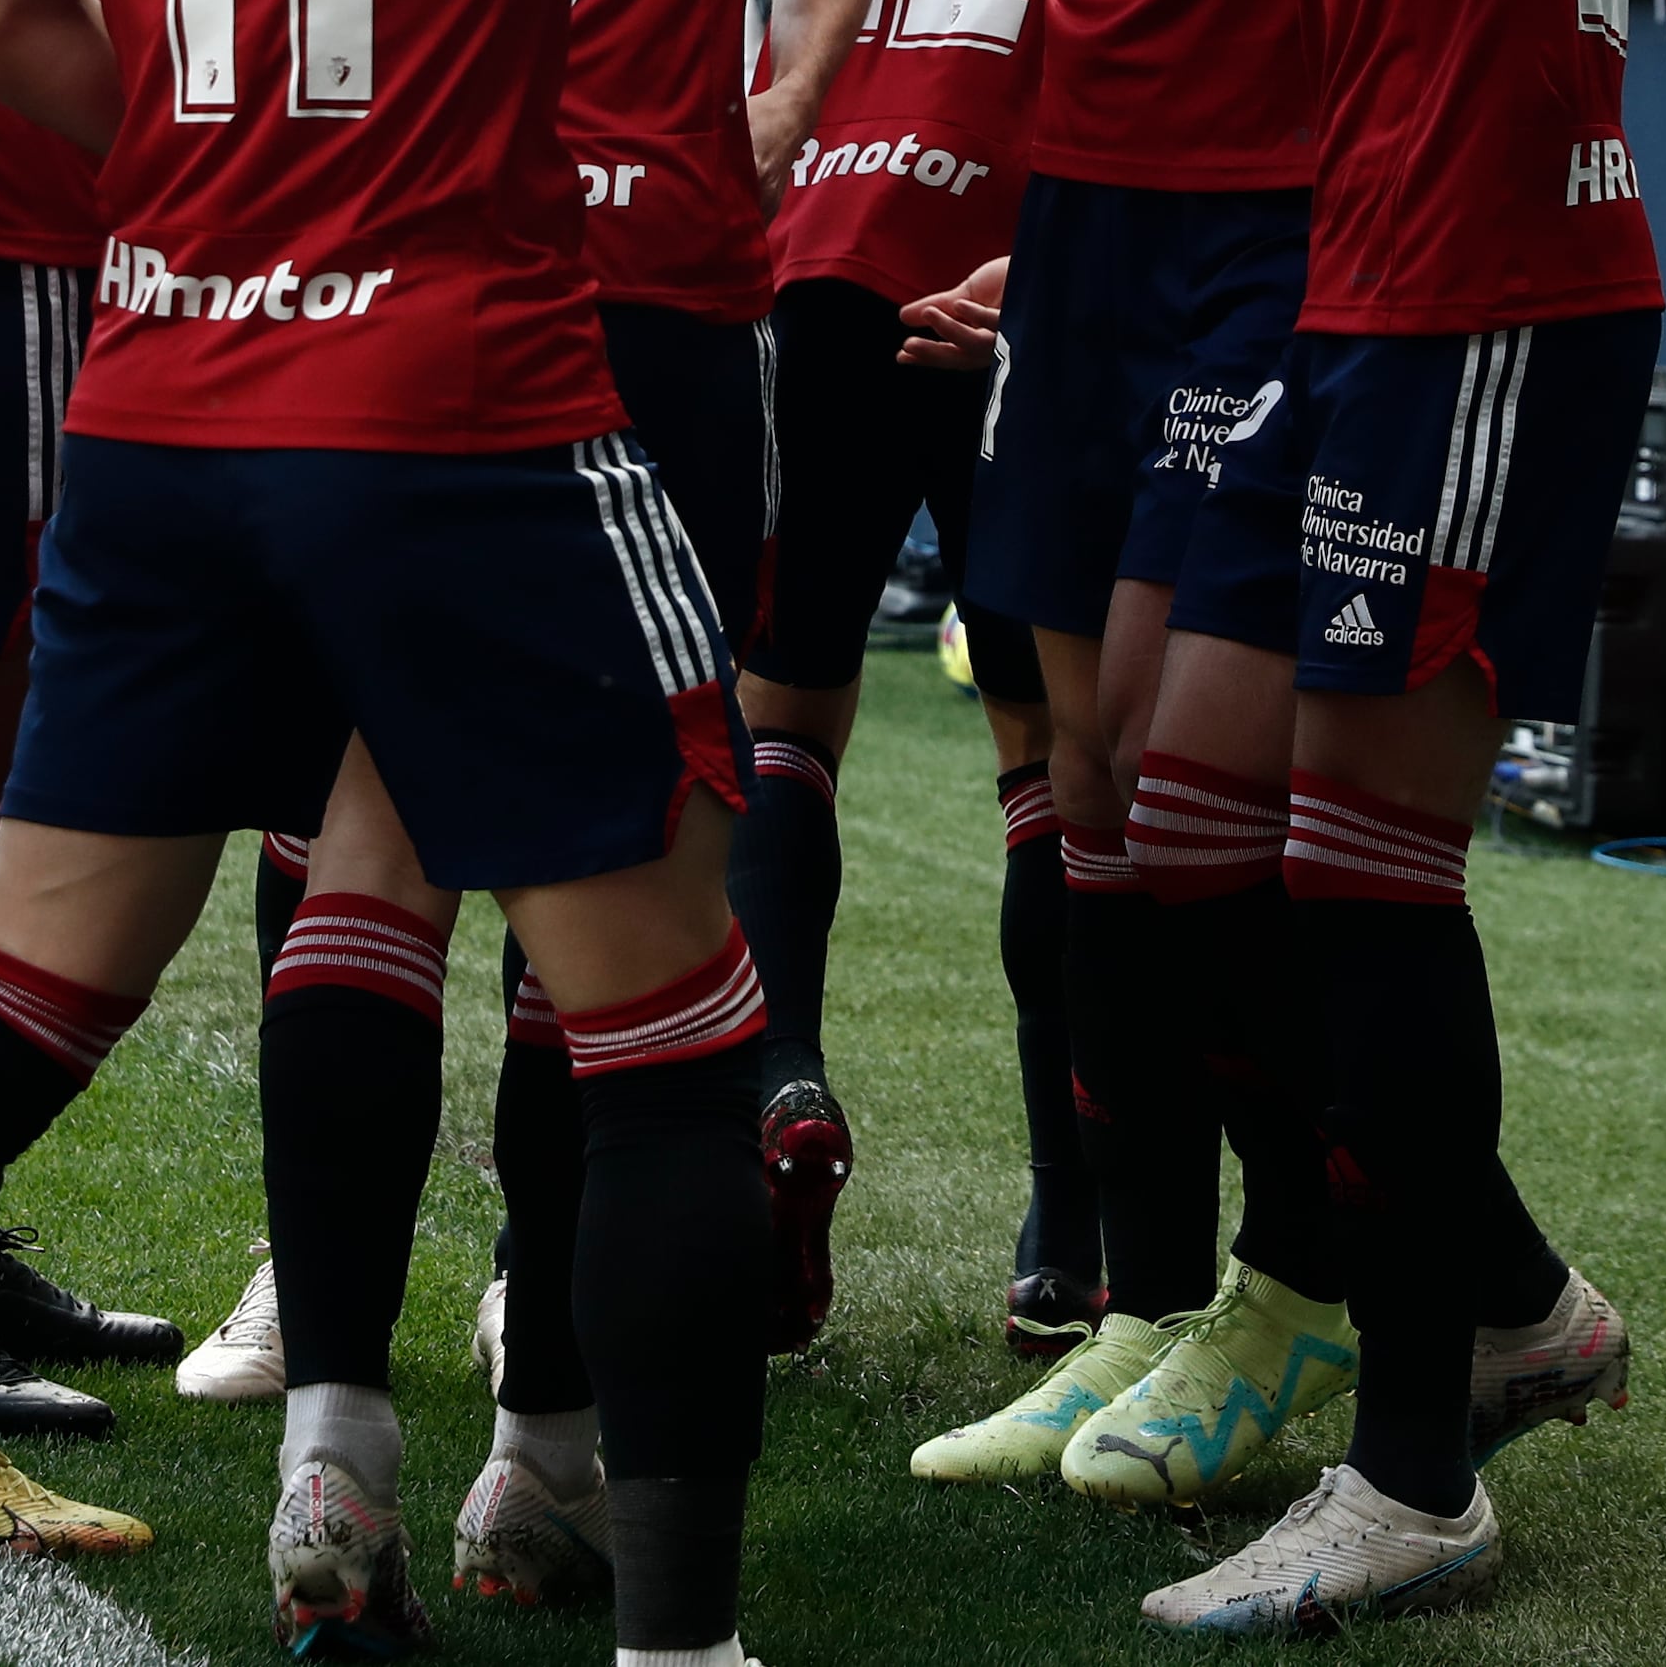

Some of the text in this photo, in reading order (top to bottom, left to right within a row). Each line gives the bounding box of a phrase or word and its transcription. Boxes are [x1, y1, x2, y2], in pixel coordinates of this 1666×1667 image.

[790, 132, 991, 197] Rmotor
[1566, 138, 1641, 207] HR
[99, 235, 394, 322] HRmotor
[1163, 415, 1231, 446] Unive
[1307, 475, 1364, 513] Clínica
[1301, 505, 1426, 557] Universidad
[1317, 540, 1407, 586] Navarra
[1324, 626, 1384, 646] adidas
